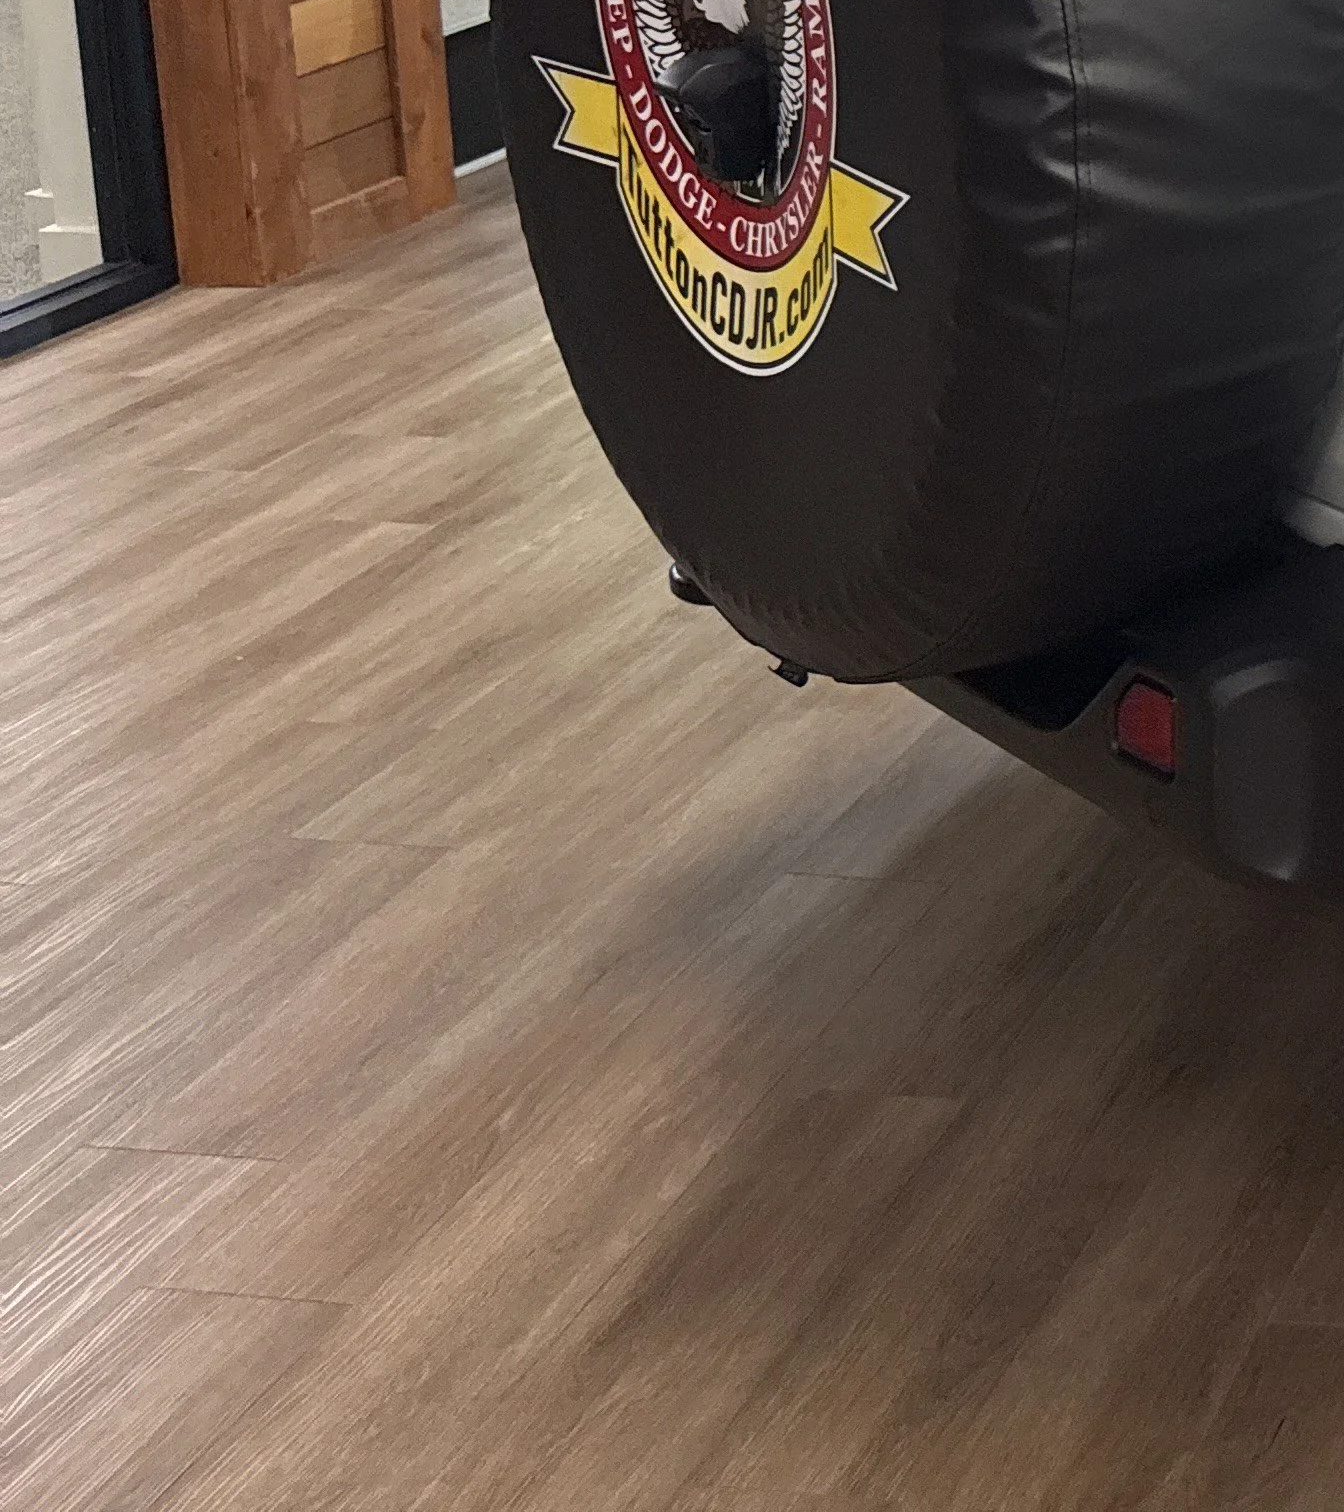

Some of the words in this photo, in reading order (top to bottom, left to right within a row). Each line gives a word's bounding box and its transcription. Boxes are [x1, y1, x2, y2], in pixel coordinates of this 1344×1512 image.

[620, 122, 829, 350] TuttonCDJR.com
[629, 80, 718, 231] DODGE
[729, 140, 824, 257] CHRYSLER
